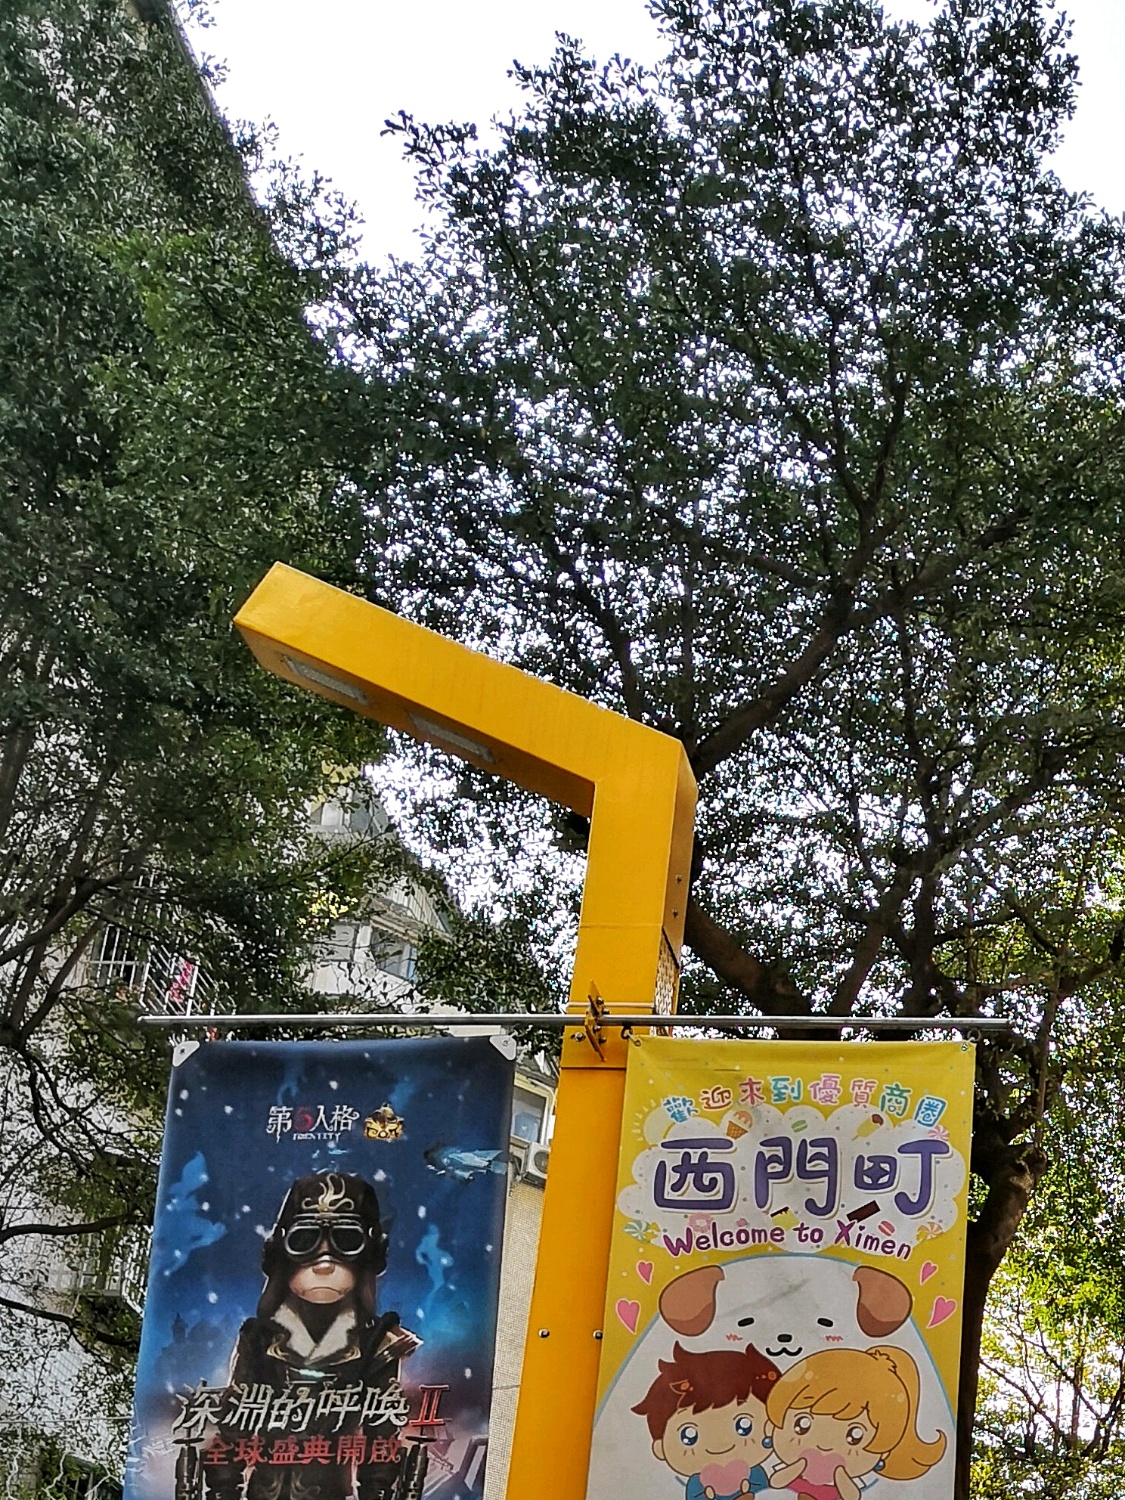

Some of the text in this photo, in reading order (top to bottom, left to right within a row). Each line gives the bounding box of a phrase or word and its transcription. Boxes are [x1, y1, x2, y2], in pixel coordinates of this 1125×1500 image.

[663, 1074, 947, 1127] 歡迎來到優質商圈
[653, 1137, 951, 1216] 西門町
[663, 1220, 912, 1260] Welcome to Ximen
